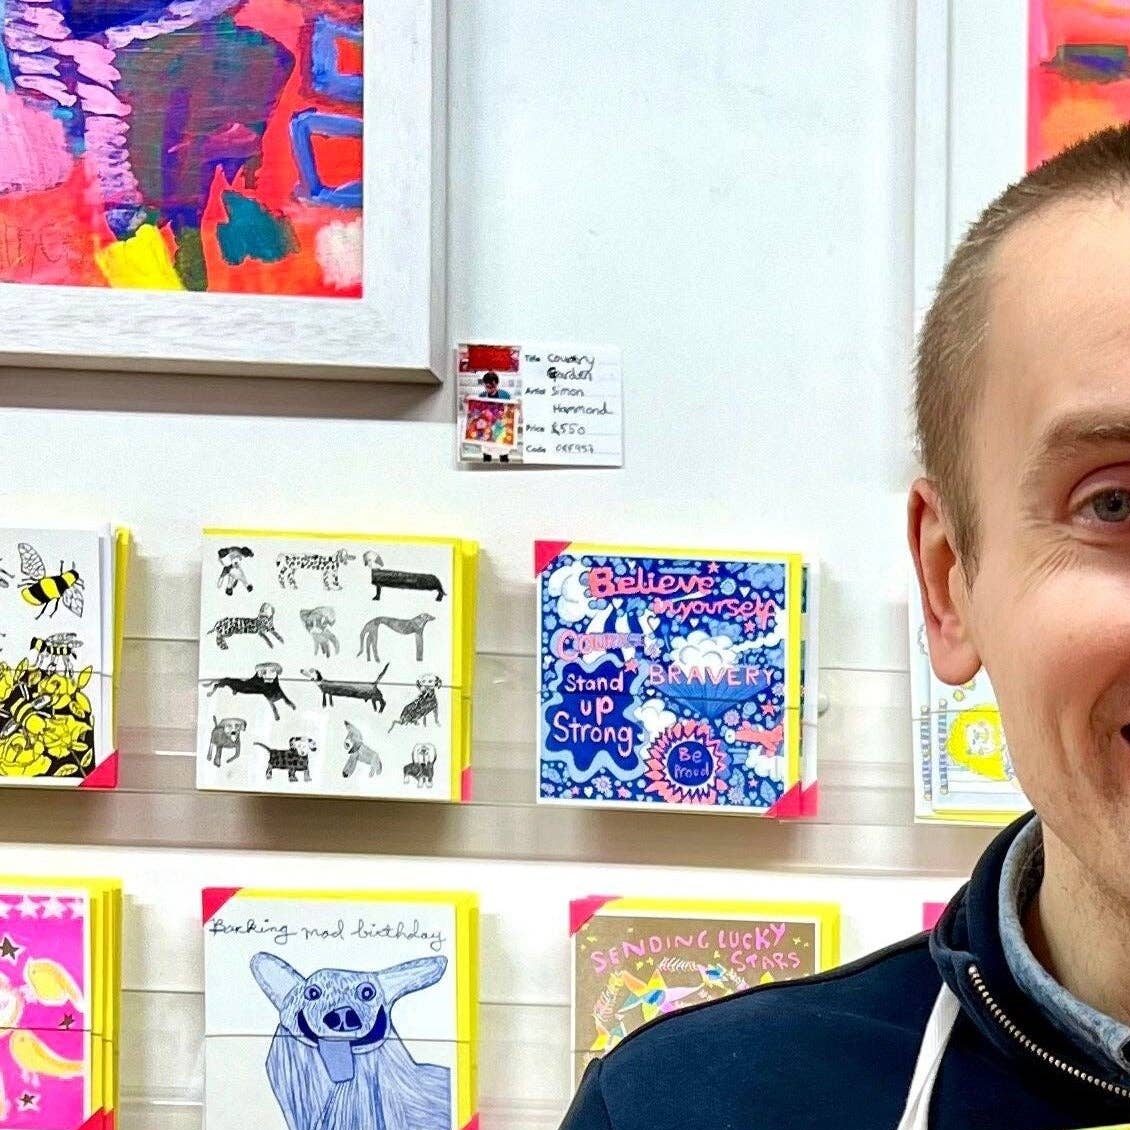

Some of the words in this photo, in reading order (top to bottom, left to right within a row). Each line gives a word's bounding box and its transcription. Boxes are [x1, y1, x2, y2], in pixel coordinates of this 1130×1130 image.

[551, 385, 584, 398] Simon
[552, 402, 613, 417] Hammond
[551, 423, 586, 437] £550
[589, 566, 715, 599] Believe
[679, 594, 777, 630] yourself
[564, 672, 624, 694] Stand
[649, 664, 775, 688] BRAVERY
[580, 695, 614, 724] up
[553, 711, 634, 758] Strong
[678, 746, 702, 762] Be
[208, 918, 297, 945] Barking
[350, 919, 447, 951] birthday
[590, 930, 709, 974] SENDING
[717, 923, 787, 951] LUCKY
[731, 949, 801, 973] STARS
